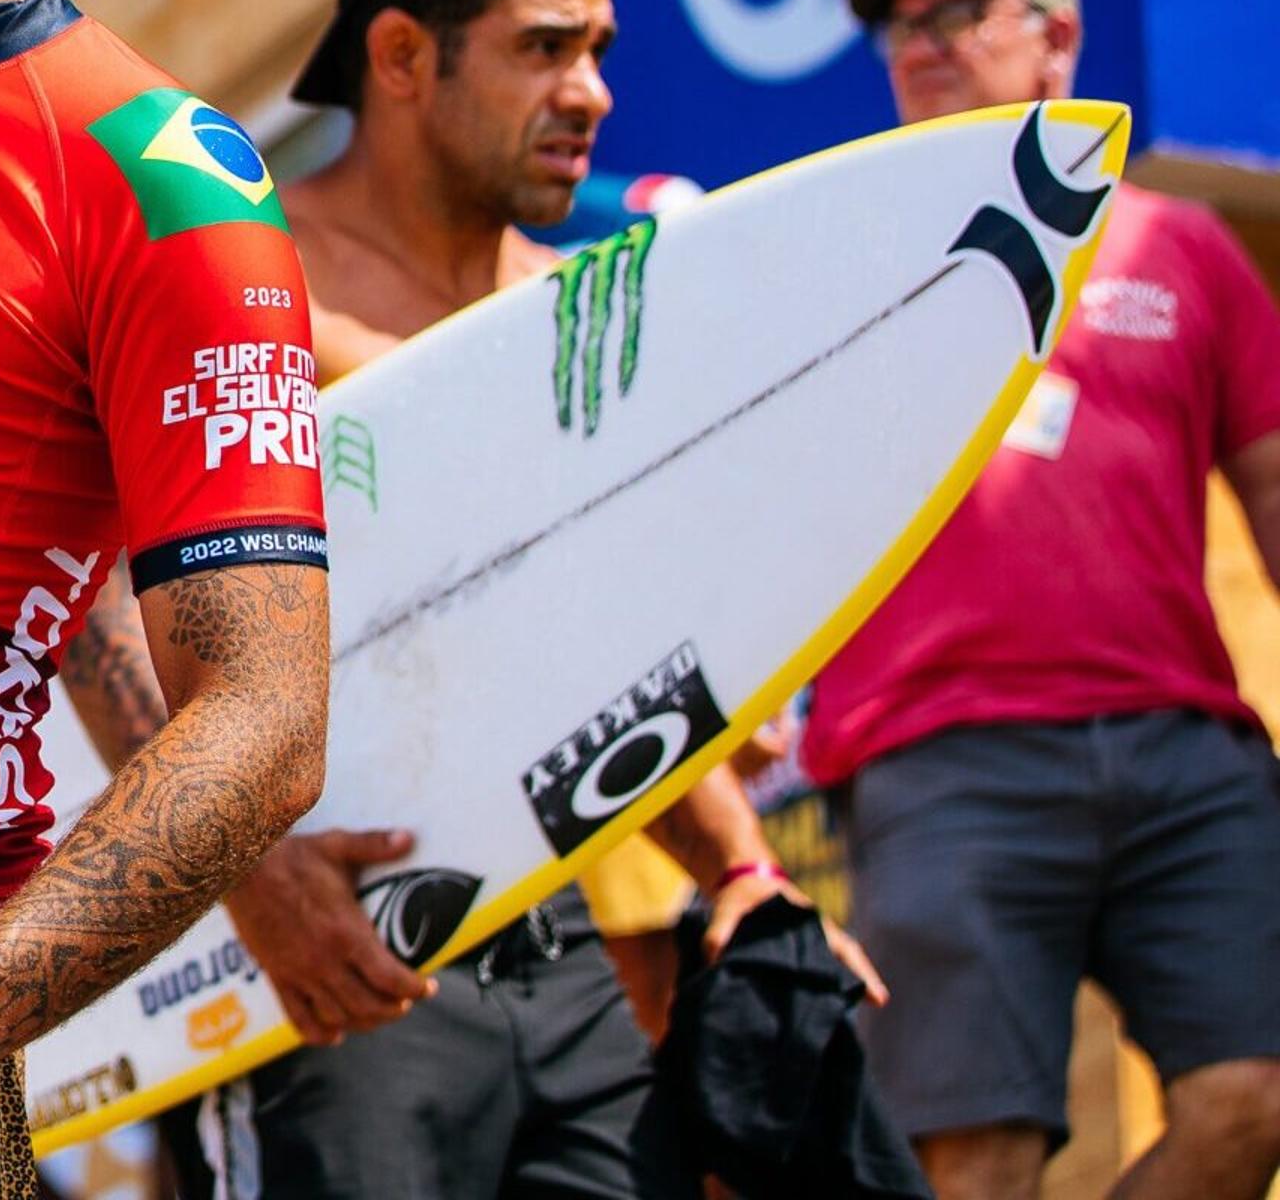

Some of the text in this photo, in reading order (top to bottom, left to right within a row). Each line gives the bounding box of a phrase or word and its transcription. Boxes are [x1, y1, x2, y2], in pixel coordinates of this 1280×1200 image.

[243, 286, 293, 309] 2023
[193, 342, 278, 381] SURF
[162, 382, 208, 426] EL
[204, 409, 318, 471] PRO
[179, 536, 238, 566] 2022
[240, 533, 285, 552] WSL
